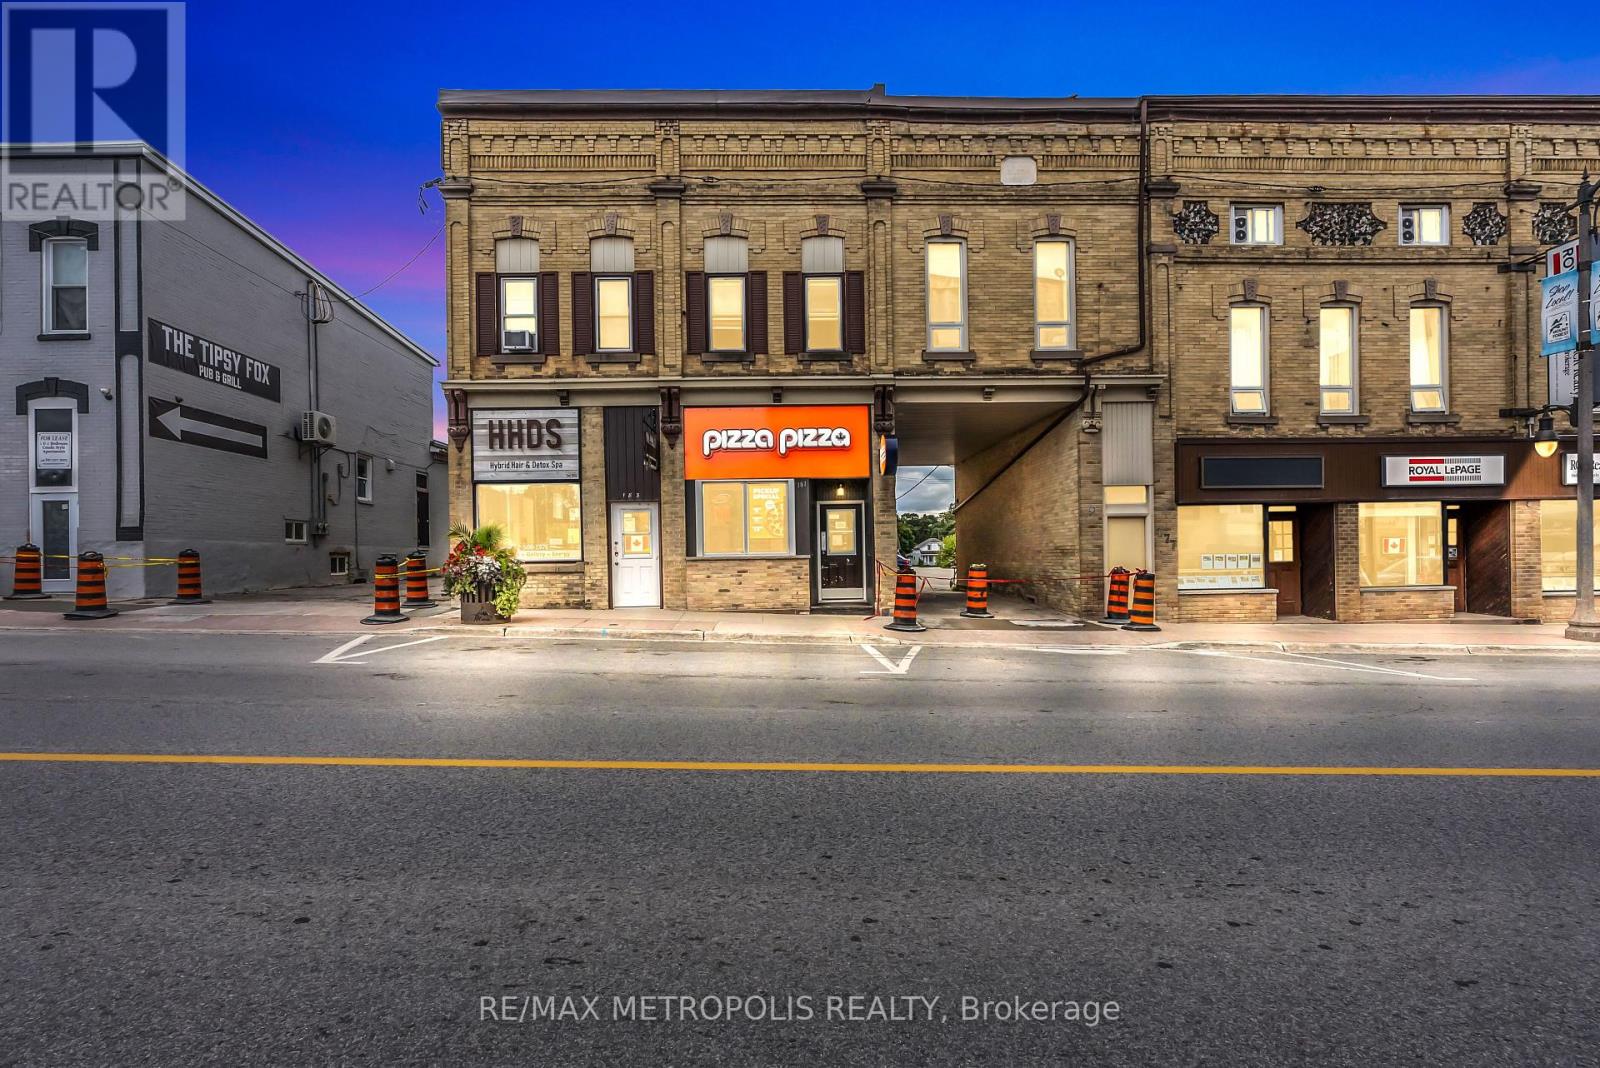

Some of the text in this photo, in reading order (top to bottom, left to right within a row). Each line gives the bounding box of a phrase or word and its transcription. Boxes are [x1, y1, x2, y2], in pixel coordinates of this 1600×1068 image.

[1549, 284, 1571, 298] Shop
[162, 325, 270, 386] THE TIPSY FOX
[199, 364, 242, 390] PUB & GRILL
[488, 418, 562, 450] HHDS
[489, 461, 510, 472] Hybrid
[511, 461, 525, 469] Hair
[532, 461, 549, 469] Detox
[551, 461, 563, 471] Spa
[1408, 465, 1442, 476] ROYAL
